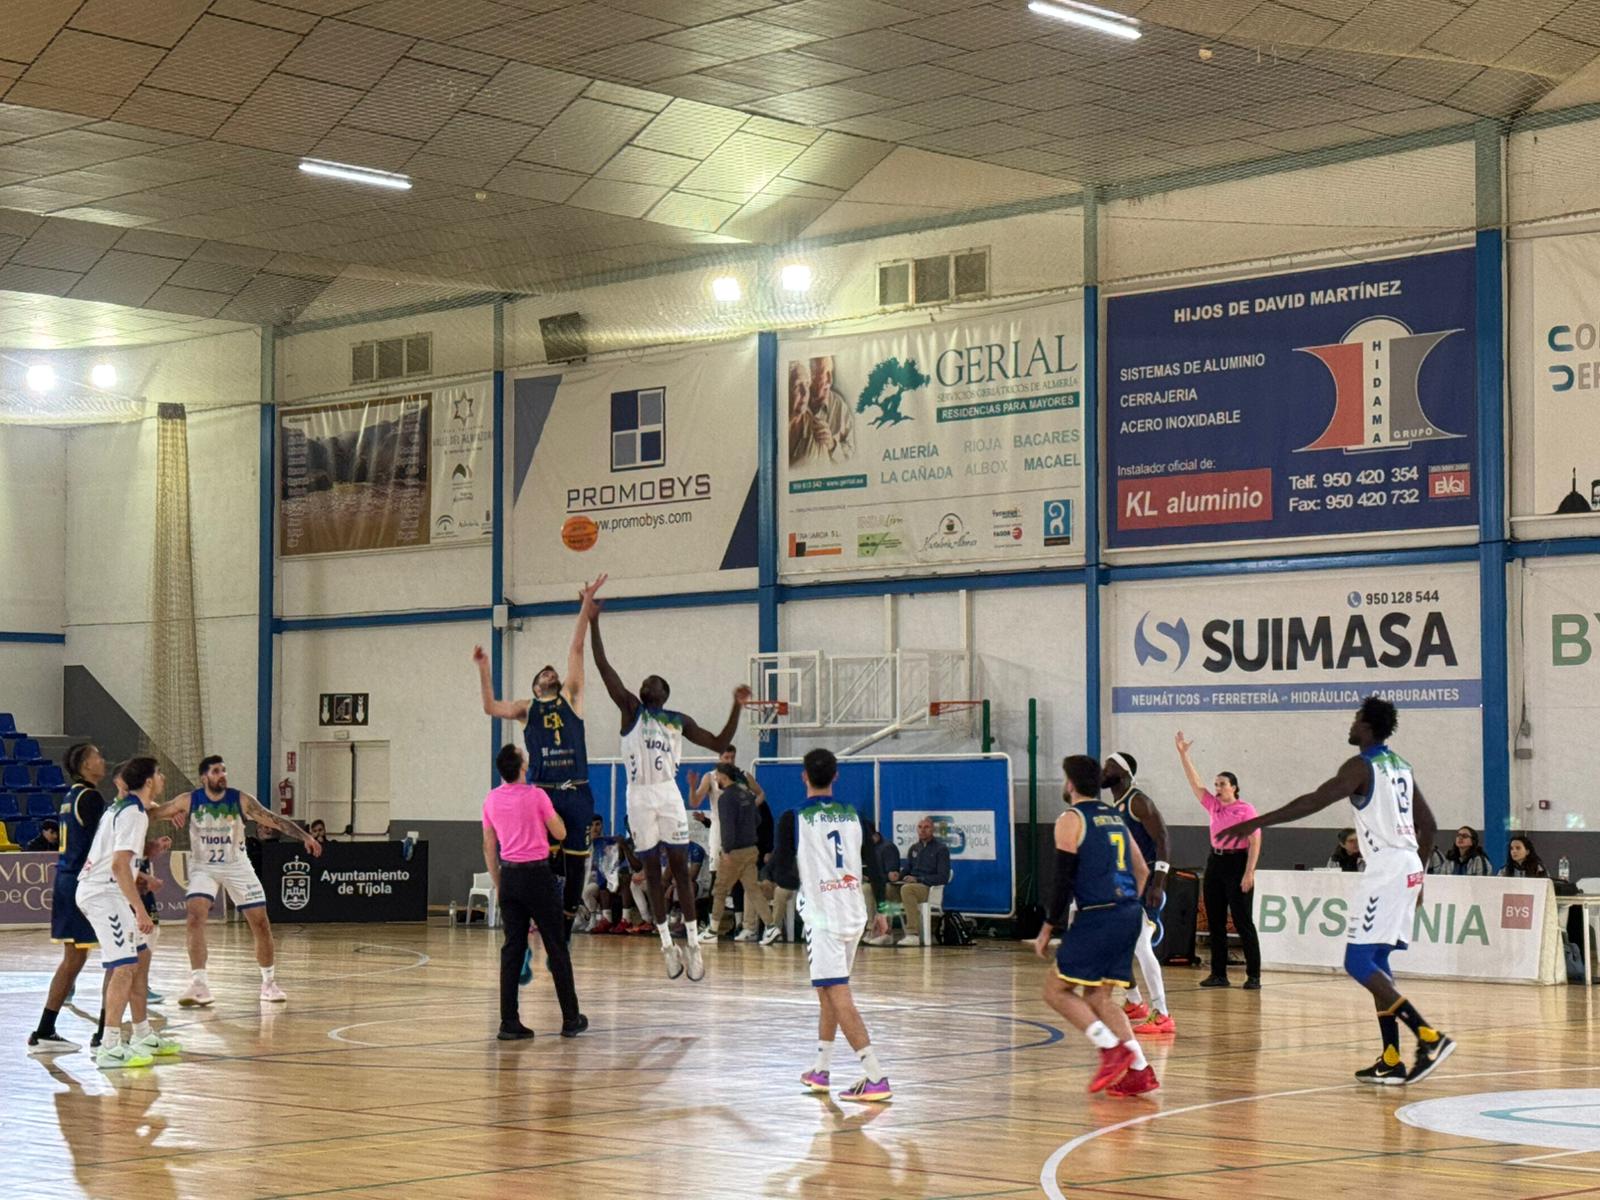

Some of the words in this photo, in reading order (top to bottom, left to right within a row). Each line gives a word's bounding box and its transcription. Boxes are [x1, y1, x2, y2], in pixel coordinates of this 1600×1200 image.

[1174, 302, 1223, 323] HIJOS
[1228, 300, 1250, 317] DE
[1255, 292, 1305, 313] DAVID
[1310, 279, 1402, 306] MARTÍNEZ
[936, 334, 1079, 387] GERIAL
[1120, 362, 1181, 381] SISTEMAS
[1183, 360, 1201, 374] DE
[1203, 353, 1266, 373] ALUMINIO
[1120, 387, 1198, 408] CERRAJERIA
[1371, 340, 1383, 444] HIDAMA
[941, 404, 1001, 420] RESIDENCIAS
[1003, 400, 1028, 413] PARA
[1029, 395, 1075, 411] MAYORES
[1120, 418, 1163, 434] ACERO
[1166, 409, 1242, 430] INOXIDABLE
[1392, 427, 1434, 439] GRUPO
[882, 442, 940, 462] ALMERÍA
[964, 437, 1002, 454] RIOJA
[1013, 428, 1081, 449] BACARES
[880, 471, 898, 485] LA
[901, 464, 953, 483] CAÑADA
[964, 459, 1009, 477] ALBOX
[1024, 453, 1081, 472] MACAEL
[1117, 463, 1166, 477] Instalador
[1168, 458, 1198, 473] oficial
[1200, 457, 1217, 470] de:
[1288, 474, 1318, 491] Telf.
[1322, 471, 1352, 488] 950
[1356, 468, 1386, 485] 420
[1391, 465, 1420, 482] 354
[567, 473, 711, 509] PROMOBYS
[1126, 491, 1159, 518] KL
[1166, 486, 1264, 514] aluminio
[1288, 497, 1322, 513] Fax:
[1325, 493, 1354, 510] 950
[1357, 491, 1388, 507] 420
[1390, 488, 1420, 505] 732
[1366, 592, 1389, 606] 950
[1391, 591, 1413, 605] 128
[1415, 589, 1440, 603] 544
[1202, 611, 1459, 673] SUIMASA
[1212, 689, 1279, 705] FERRETERÍA
[1290, 687, 1360, 704] HIDRÁULICA
[1371, 687, 1460, 701] CARBURANTES
[655, 755, 663, 771] 6
[209, 849, 225, 863] 22
[826, 829, 844, 869] 1
[1108, 831, 1128, 872] 7
[320, 868, 410, 885] Ayuntamiento
[337, 883, 354, 895] de
[356, 881, 393, 897] Tíjola
[1505, 906, 1530, 919] BYS
